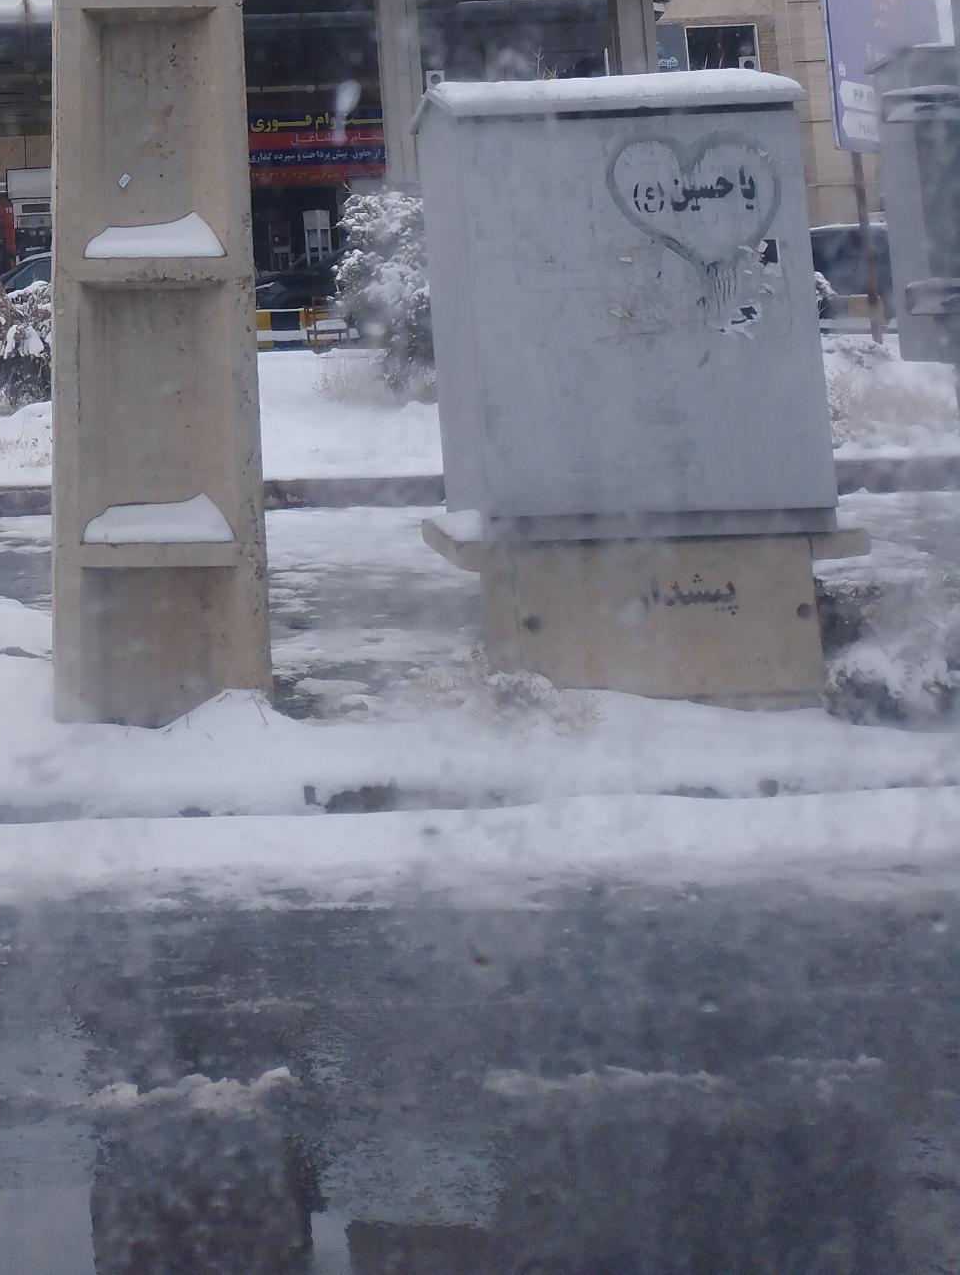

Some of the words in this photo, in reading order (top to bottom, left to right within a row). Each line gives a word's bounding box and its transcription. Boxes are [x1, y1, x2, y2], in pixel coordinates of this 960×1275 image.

[250, 114, 313, 133] فوری
[670, 175, 734, 213] حسین
[739, 166, 756, 211] یا
